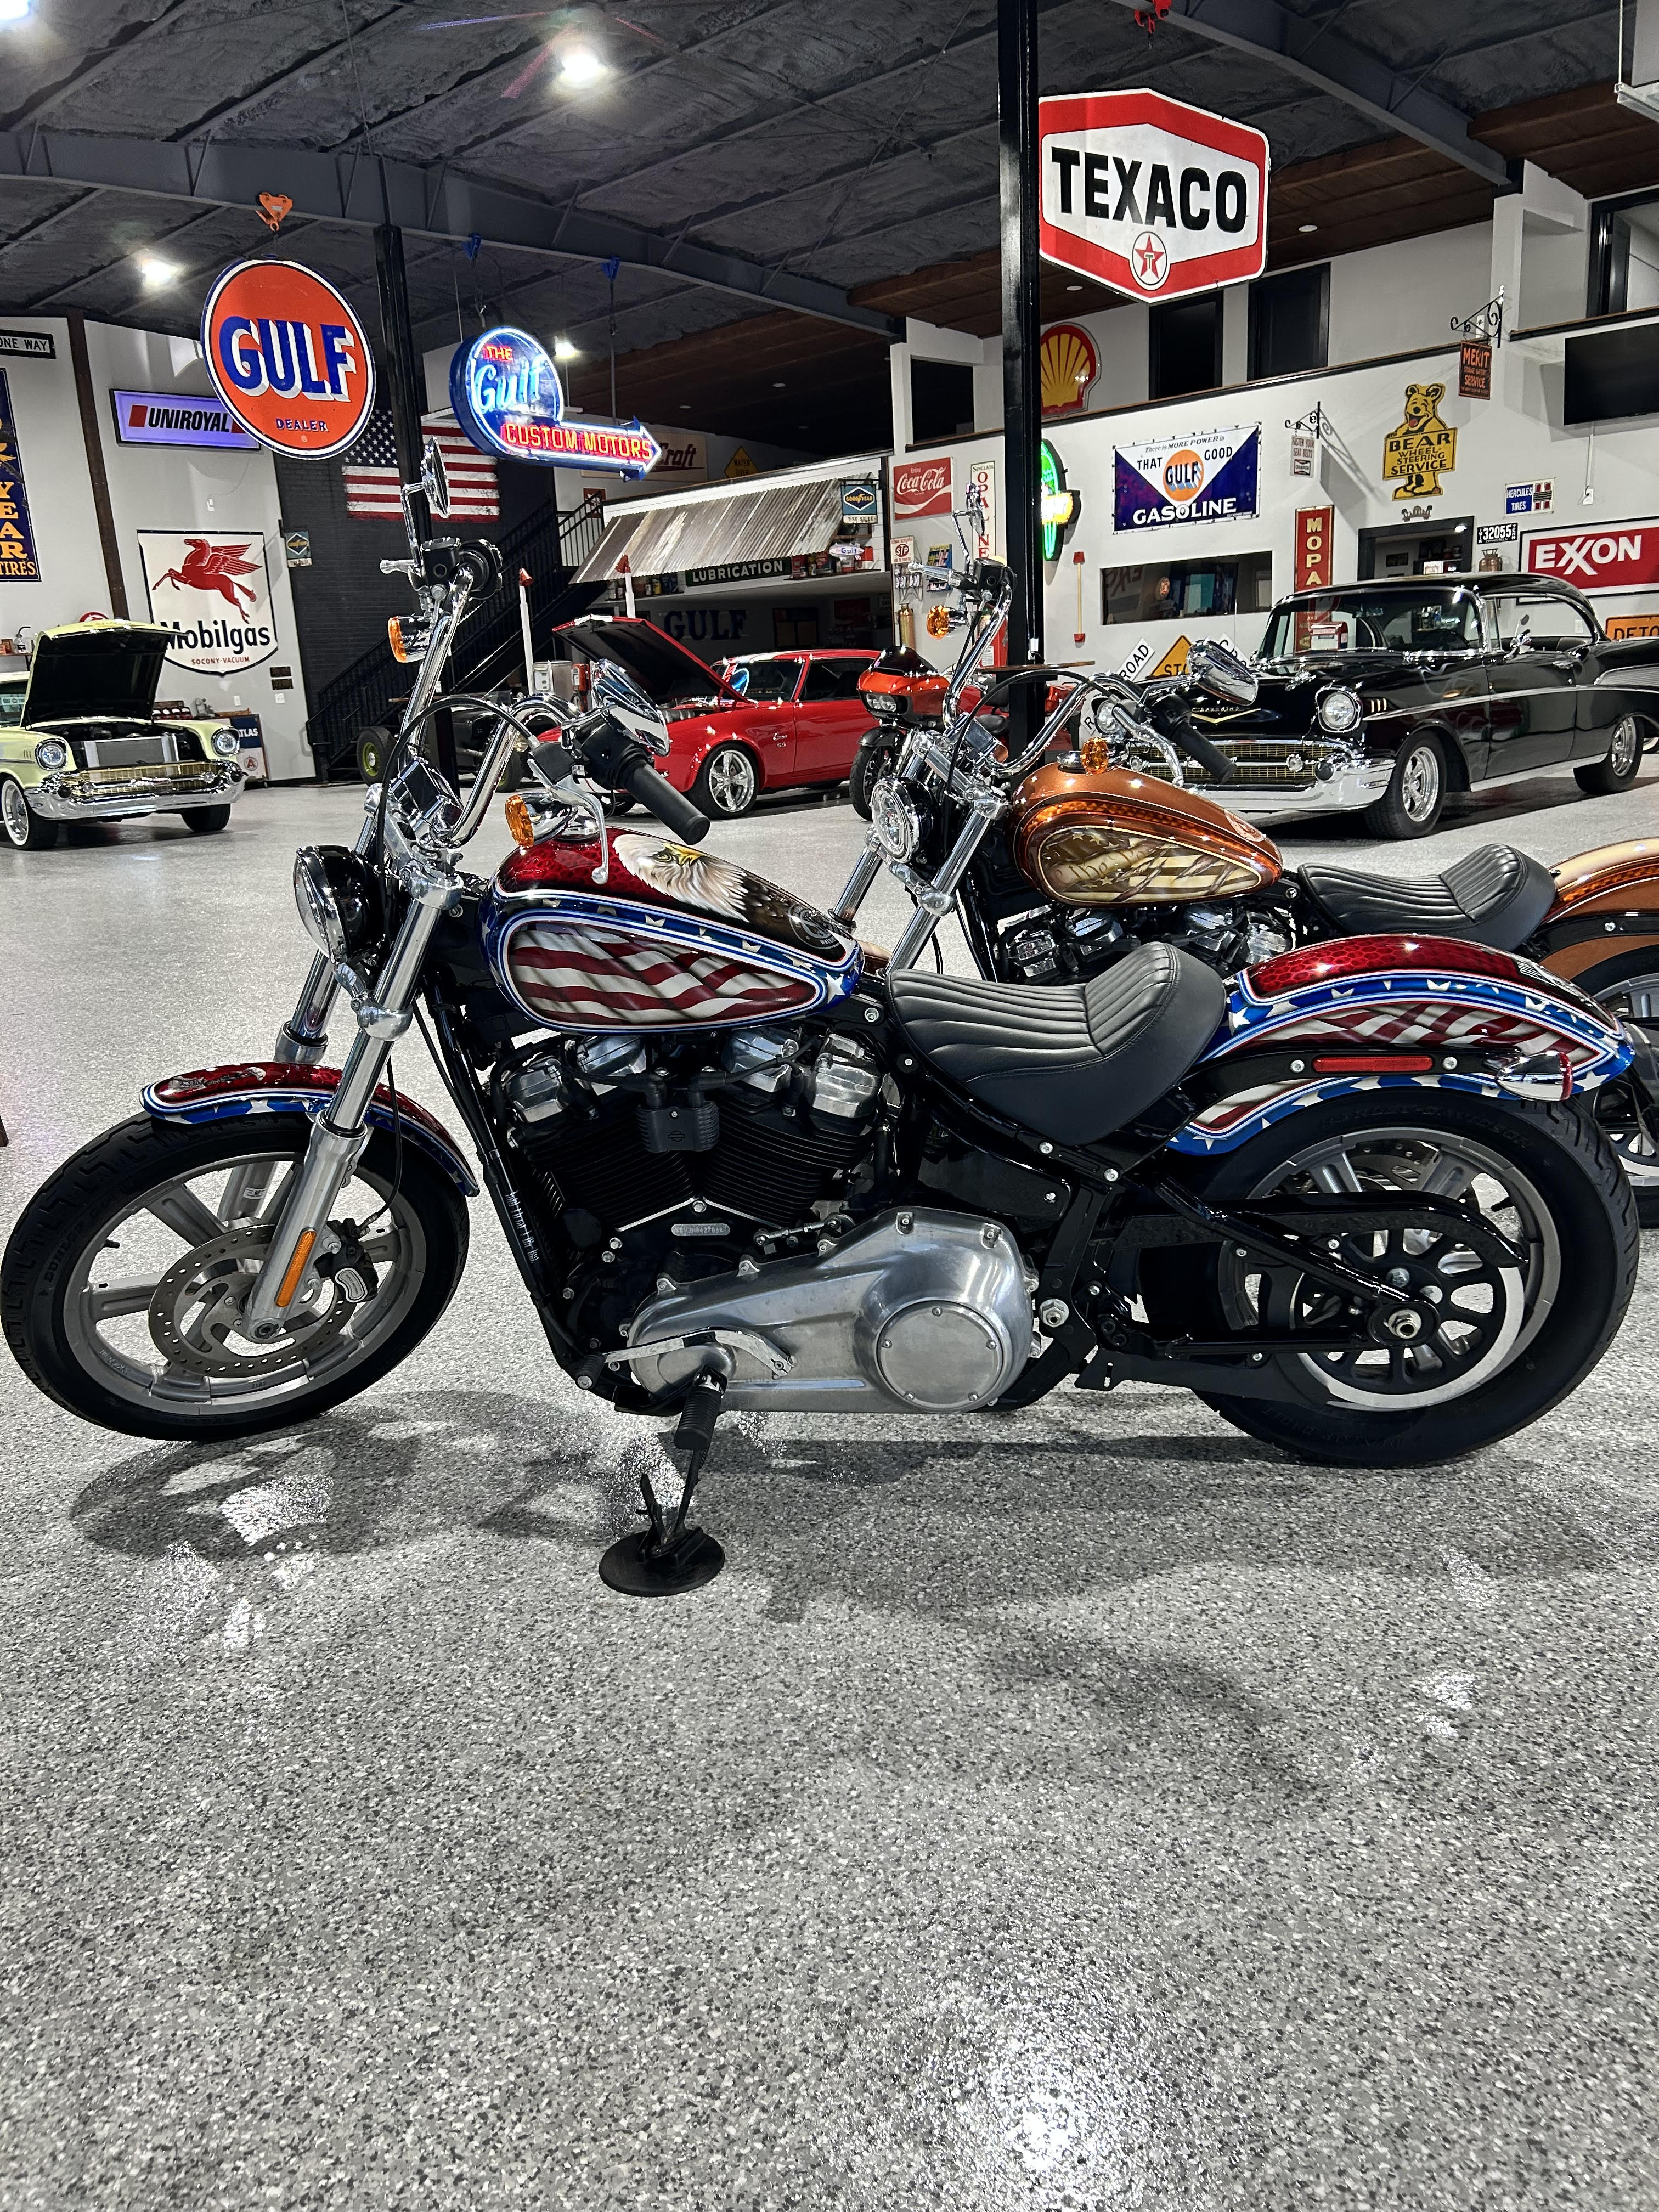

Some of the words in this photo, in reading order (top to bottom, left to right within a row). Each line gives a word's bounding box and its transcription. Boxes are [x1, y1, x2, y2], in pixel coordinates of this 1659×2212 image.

[1051, 146, 1247, 233] TEXACO
[24, 339, 47, 351] WAY
[486, 345, 513, 360] THE
[219, 315, 357, 403] GULF
[1463, 347, 1490, 369] MERIT
[475, 354, 546, 414] Gulf
[1465, 375, 1485, 388] SERVICE
[148, 408, 230, 432] UNIROYAL
[276, 418, 330, 433] DEALER
[505, 423, 578, 450] CUSTOM
[584, 431, 653, 460] MOTORS
[1168, 440, 1189, 449] MORE
[1190, 436, 1218, 446] POWER
[1389, 433, 1451, 452] BEAR
[1137, 457, 1163, 471] THAT
[1204, 447, 1233, 461] GOOD
[1391, 459, 1447, 475] SERVICE
[1397, 452, 1444, 465] STEERING
[896, 467, 946, 495] Coca-Cola
[1165, 461, 1202, 492] GULF
[845, 494, 873, 503] GOODYEAR
[1506, 487, 1533, 499] HERCULES
[1133, 498, 1237, 524] GASOLINE
[1511, 501, 1526, 511] TIRES
[1482, 524, 1511, 540] 32055
[896, 545, 909, 556] STP
[1306, 517, 1322, 586] MOPA
[1535, 535, 1643, 575] EXXON
[692, 560, 783, 583] LUBRICATION
[160, 619, 270, 654] Mobilgas
[664, 610, 747, 641] GULF
[191, 657, 250, 665] SOCONY-VACUUM
